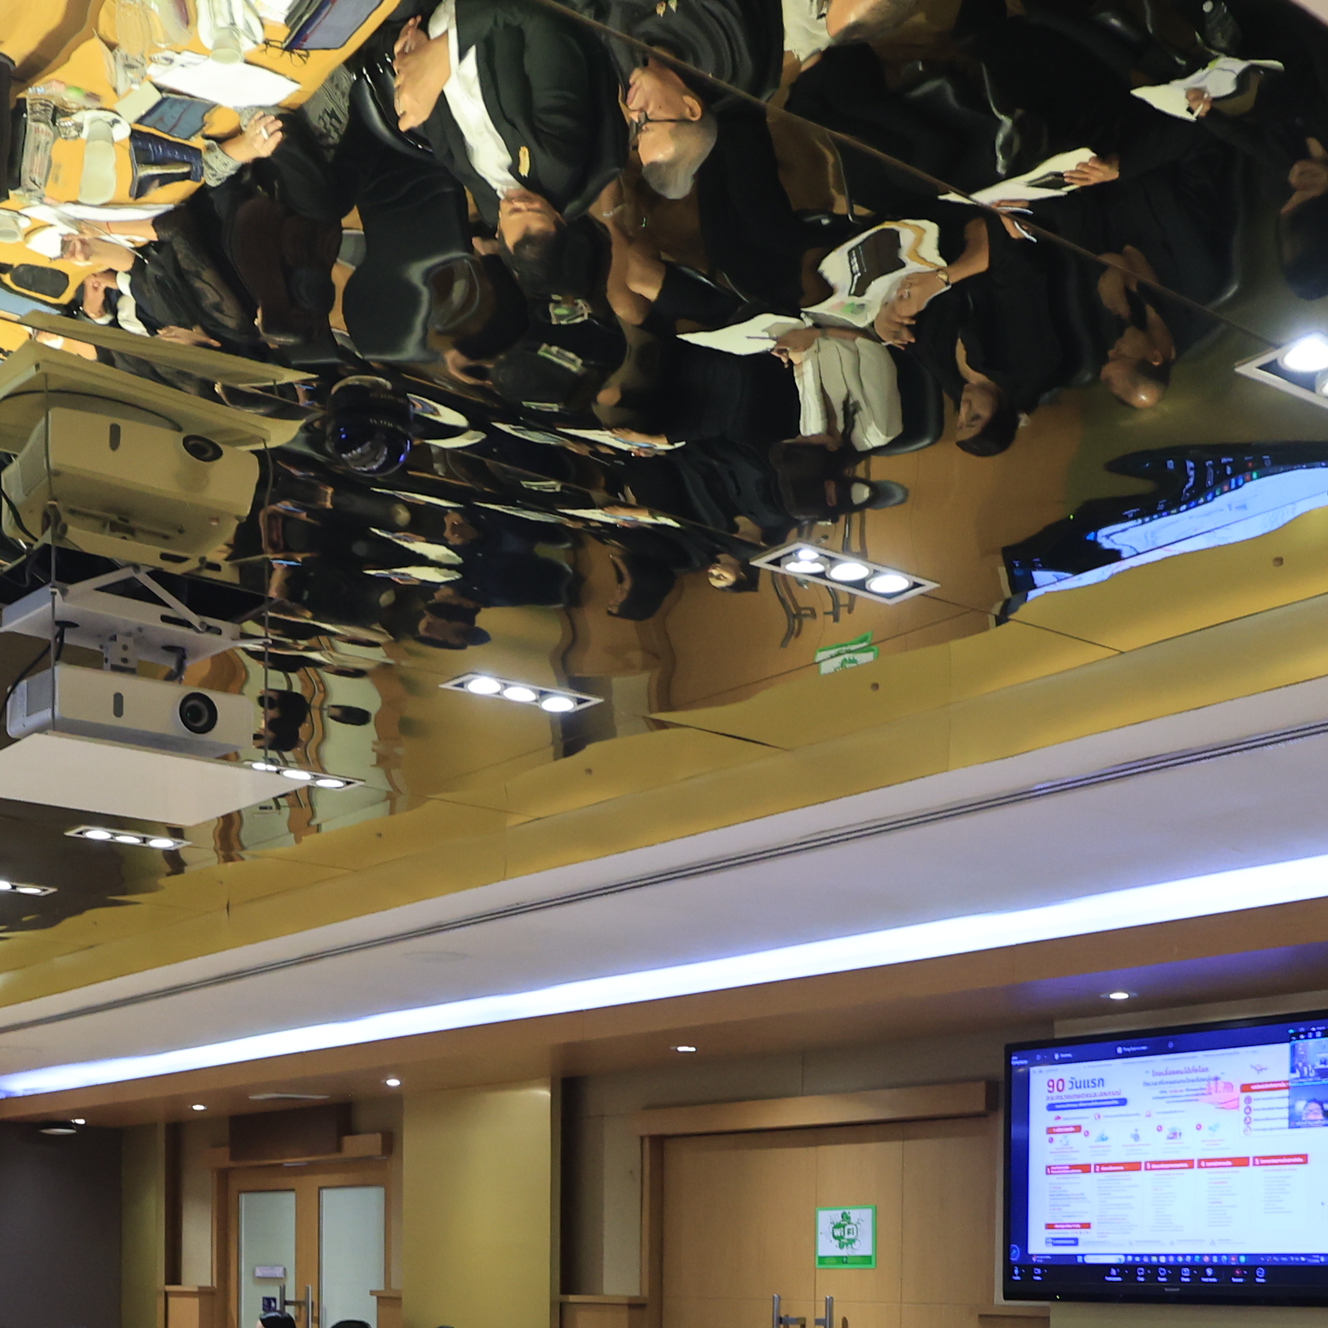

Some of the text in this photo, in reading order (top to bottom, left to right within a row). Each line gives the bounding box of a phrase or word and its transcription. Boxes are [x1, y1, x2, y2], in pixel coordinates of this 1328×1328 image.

[1047, 1076, 1105, 1093] 90 วันแรก
